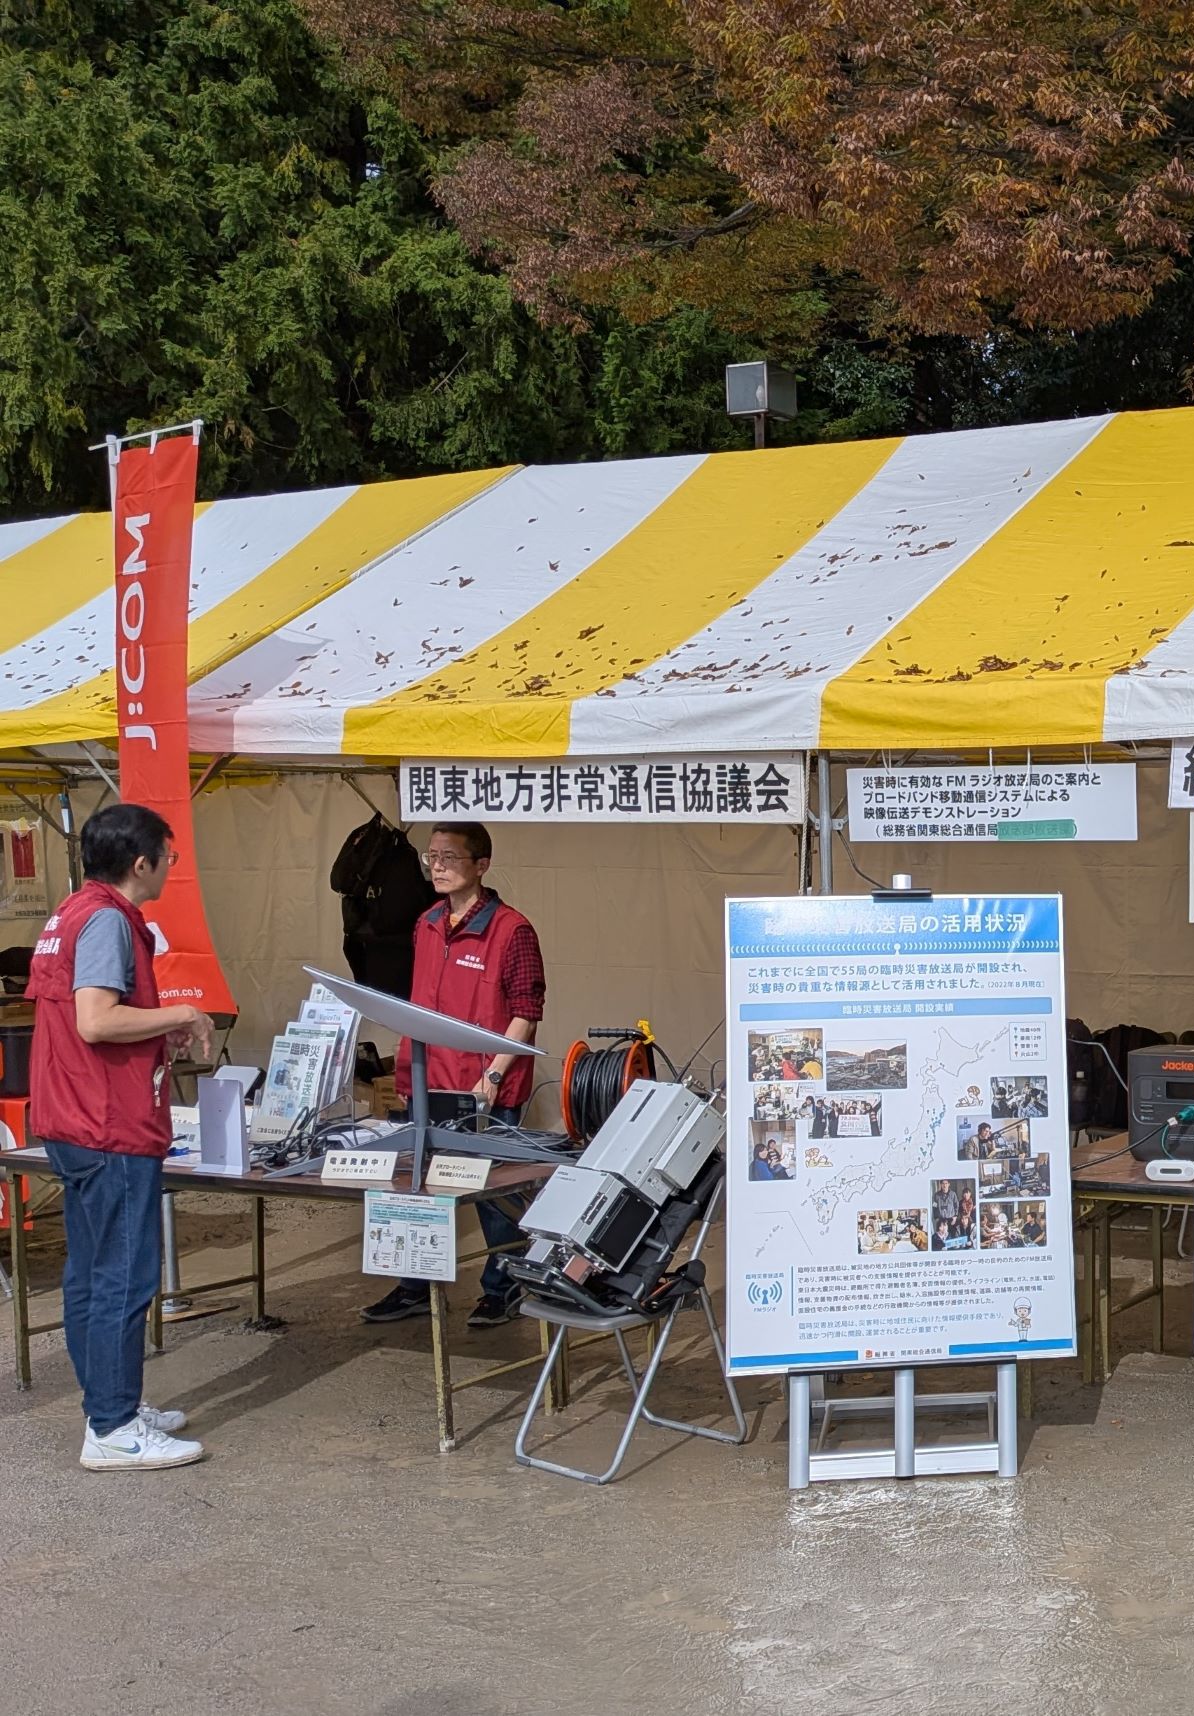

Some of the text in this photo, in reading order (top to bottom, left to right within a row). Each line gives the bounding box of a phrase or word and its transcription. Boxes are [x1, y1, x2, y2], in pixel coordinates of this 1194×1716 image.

[121, 513, 157, 751] J:COM
[408, 762, 791, 814] 関東地方非常通信協議会
[864, 805, 1022, 820] 映像伝送デモンストレーション
